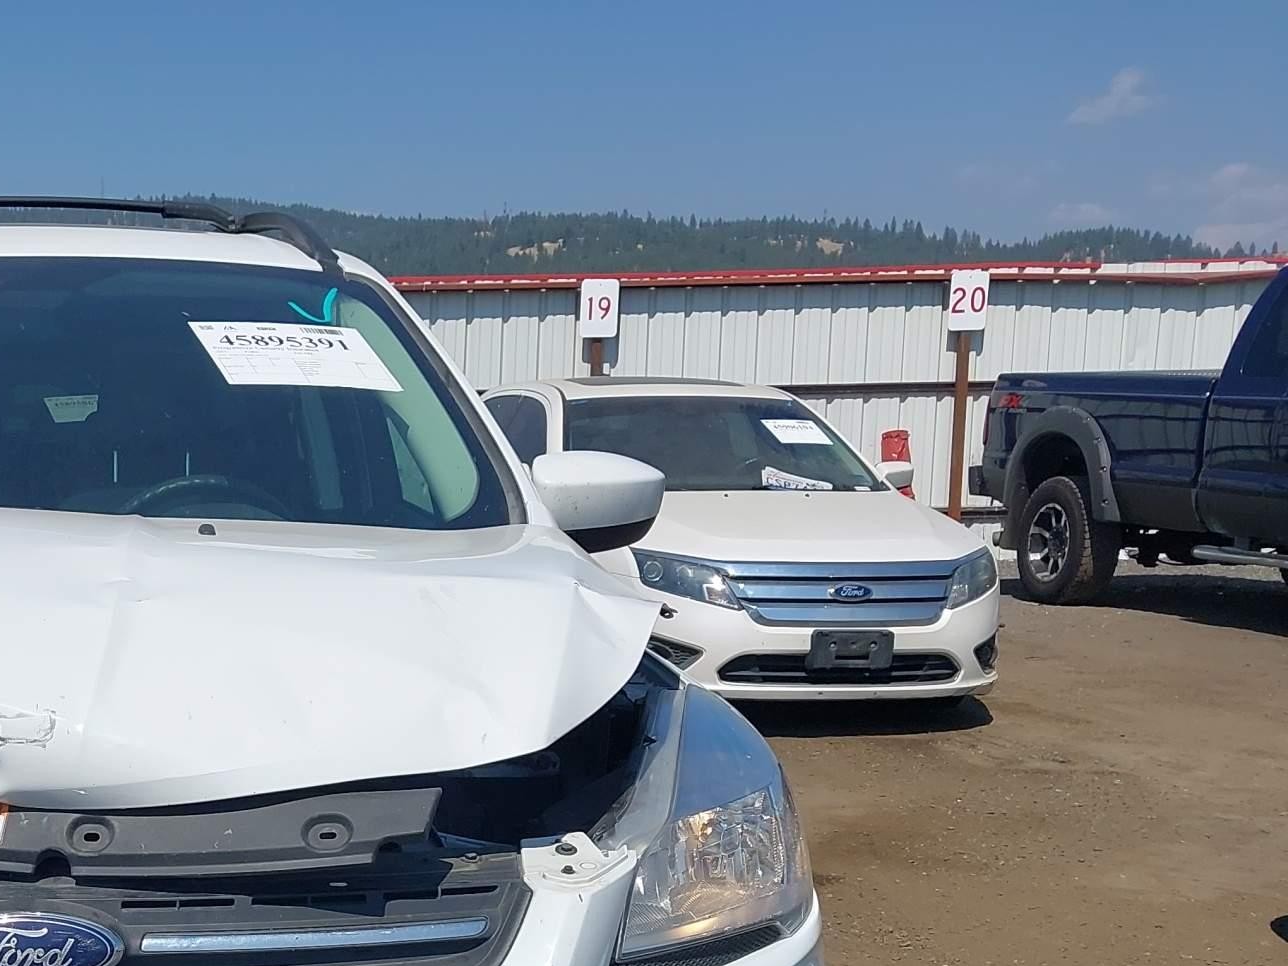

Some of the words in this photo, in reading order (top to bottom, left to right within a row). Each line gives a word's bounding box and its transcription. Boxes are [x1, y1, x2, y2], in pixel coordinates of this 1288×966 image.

[587, 296, 611, 321] 19
[951, 286, 986, 314] 20
[218, 333, 350, 352] 45895391
[840, 585, 865, 597] Ford
